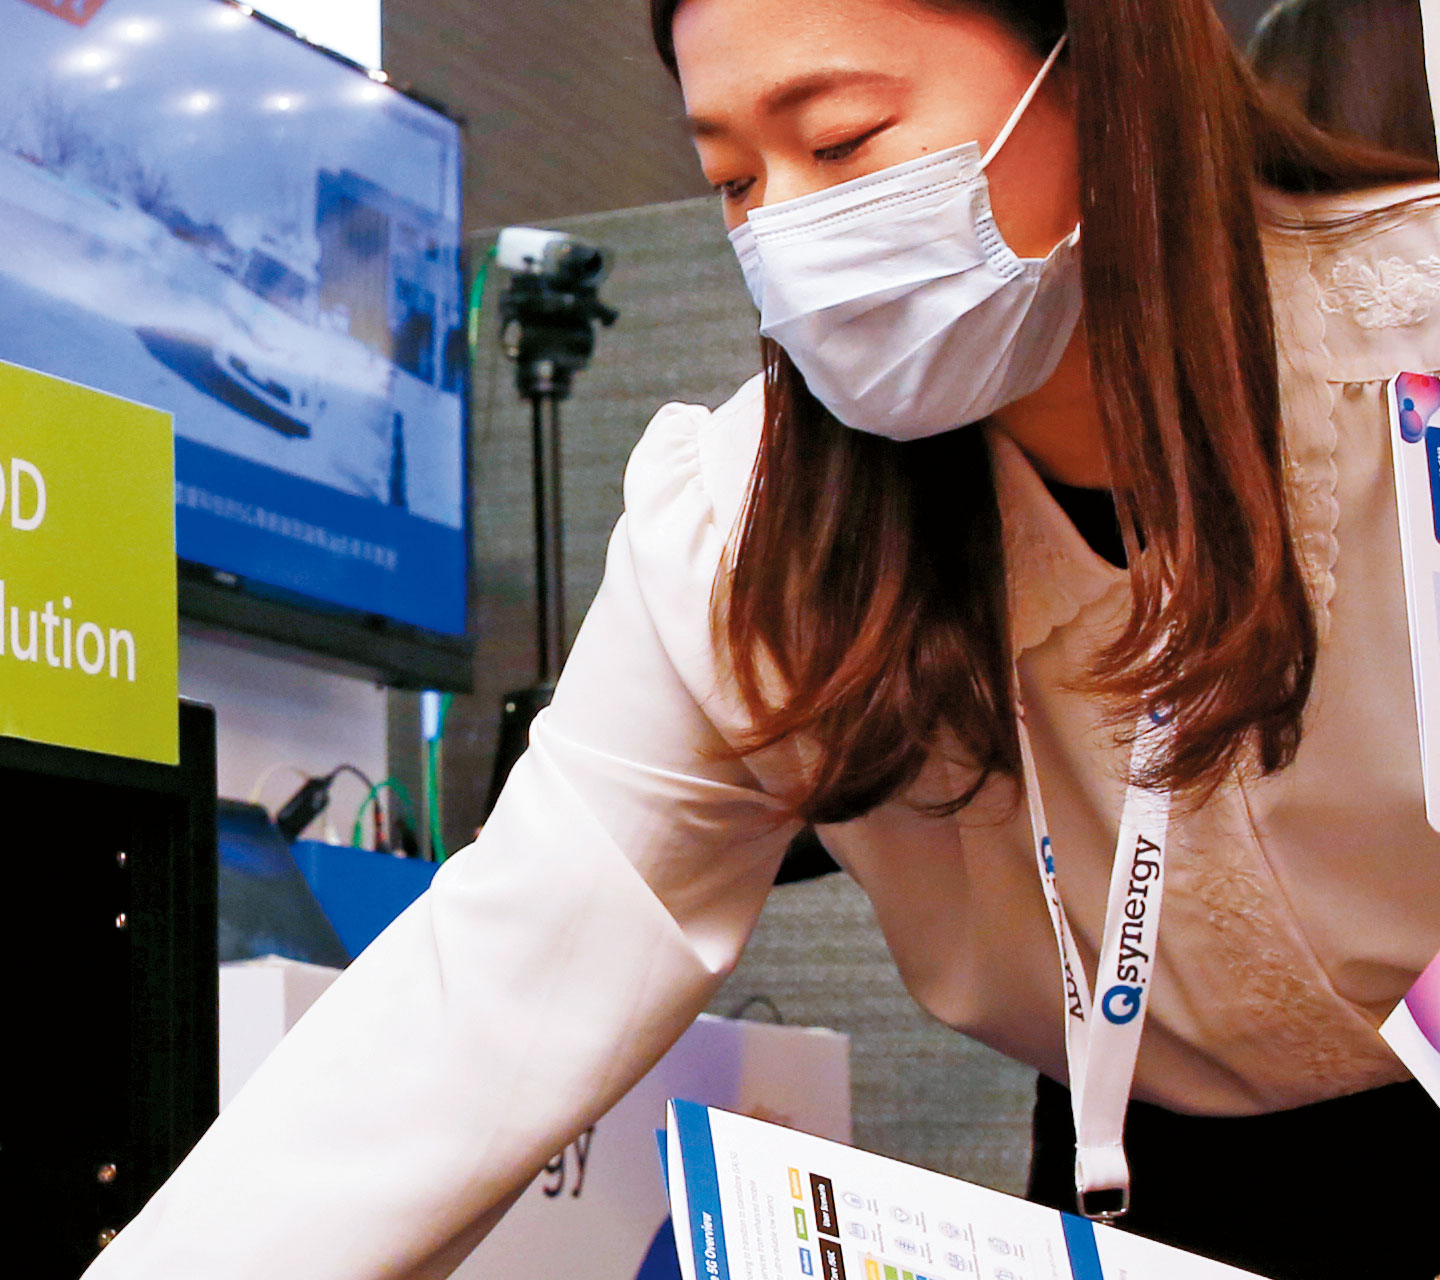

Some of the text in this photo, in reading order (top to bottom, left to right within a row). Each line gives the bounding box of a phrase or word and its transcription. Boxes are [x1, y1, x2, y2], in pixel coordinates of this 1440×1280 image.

[816, 1182, 832, 1228] User Scenario
[703, 1211, 717, 1258] Overview
[707, 1259, 720, 1275] 5G
